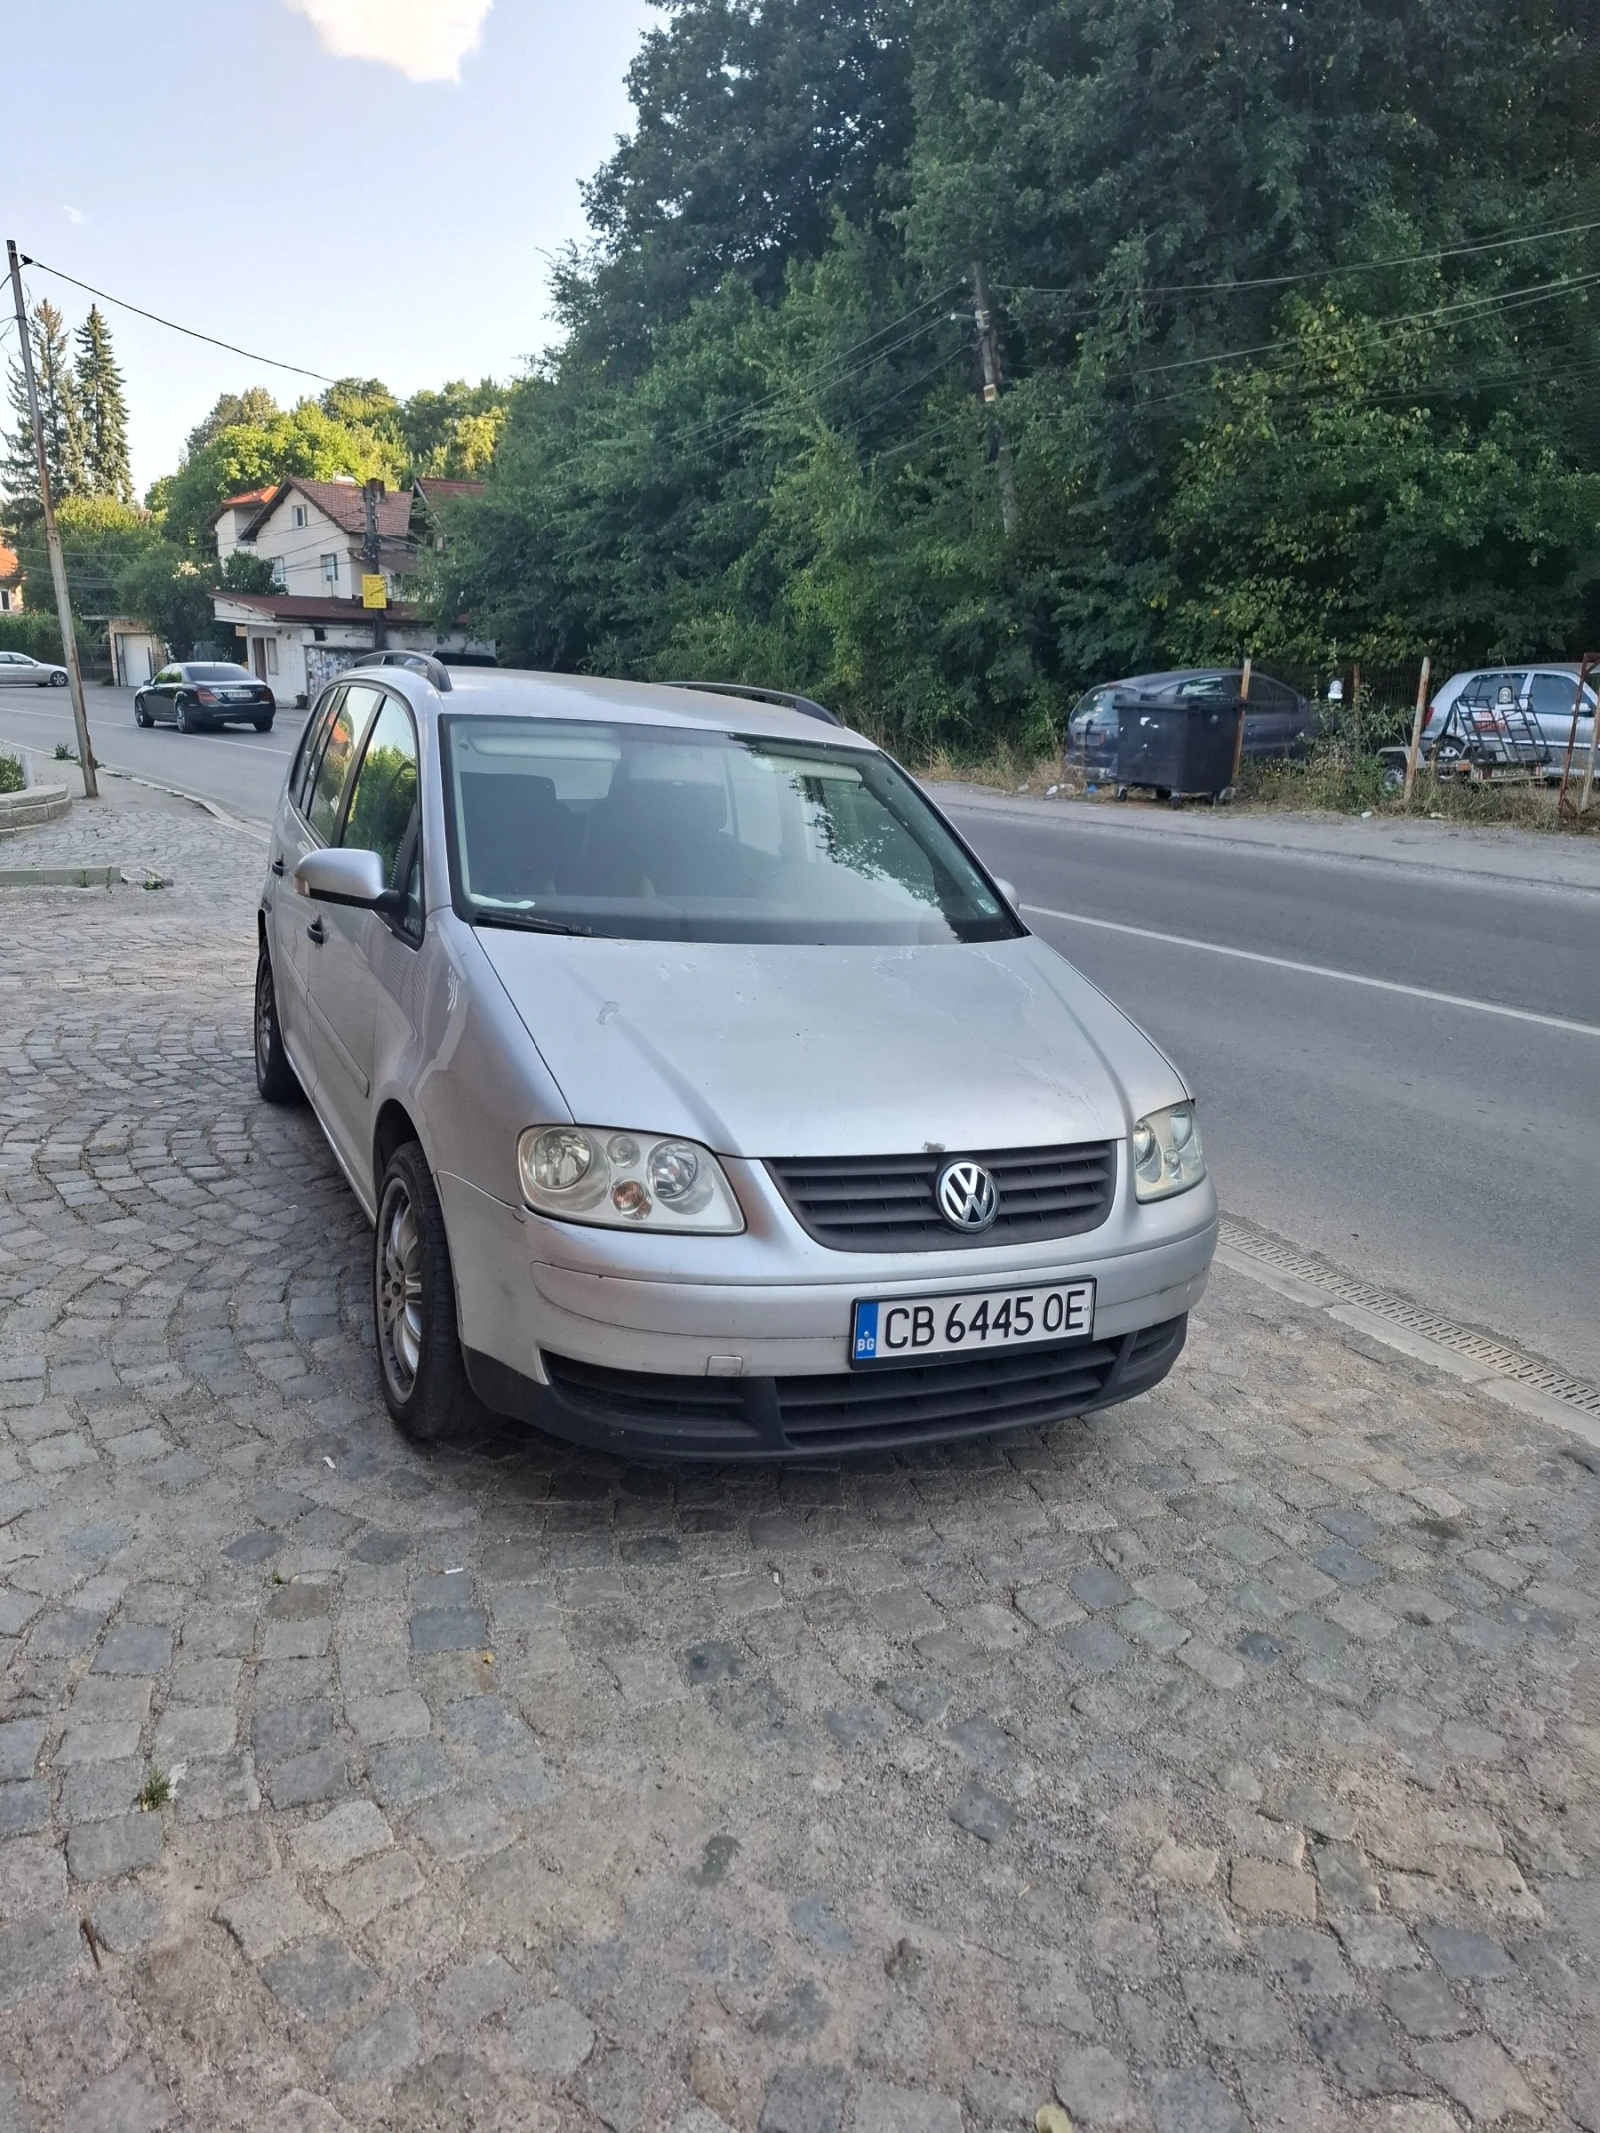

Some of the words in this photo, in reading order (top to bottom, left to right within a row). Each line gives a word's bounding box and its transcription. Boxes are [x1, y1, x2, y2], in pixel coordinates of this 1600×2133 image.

[884, 1306, 935, 1348] CB
[945, 1296, 1034, 1343] 6445
[1042, 1290, 1086, 1332] OE
[857, 1337, 875, 1351] BG
